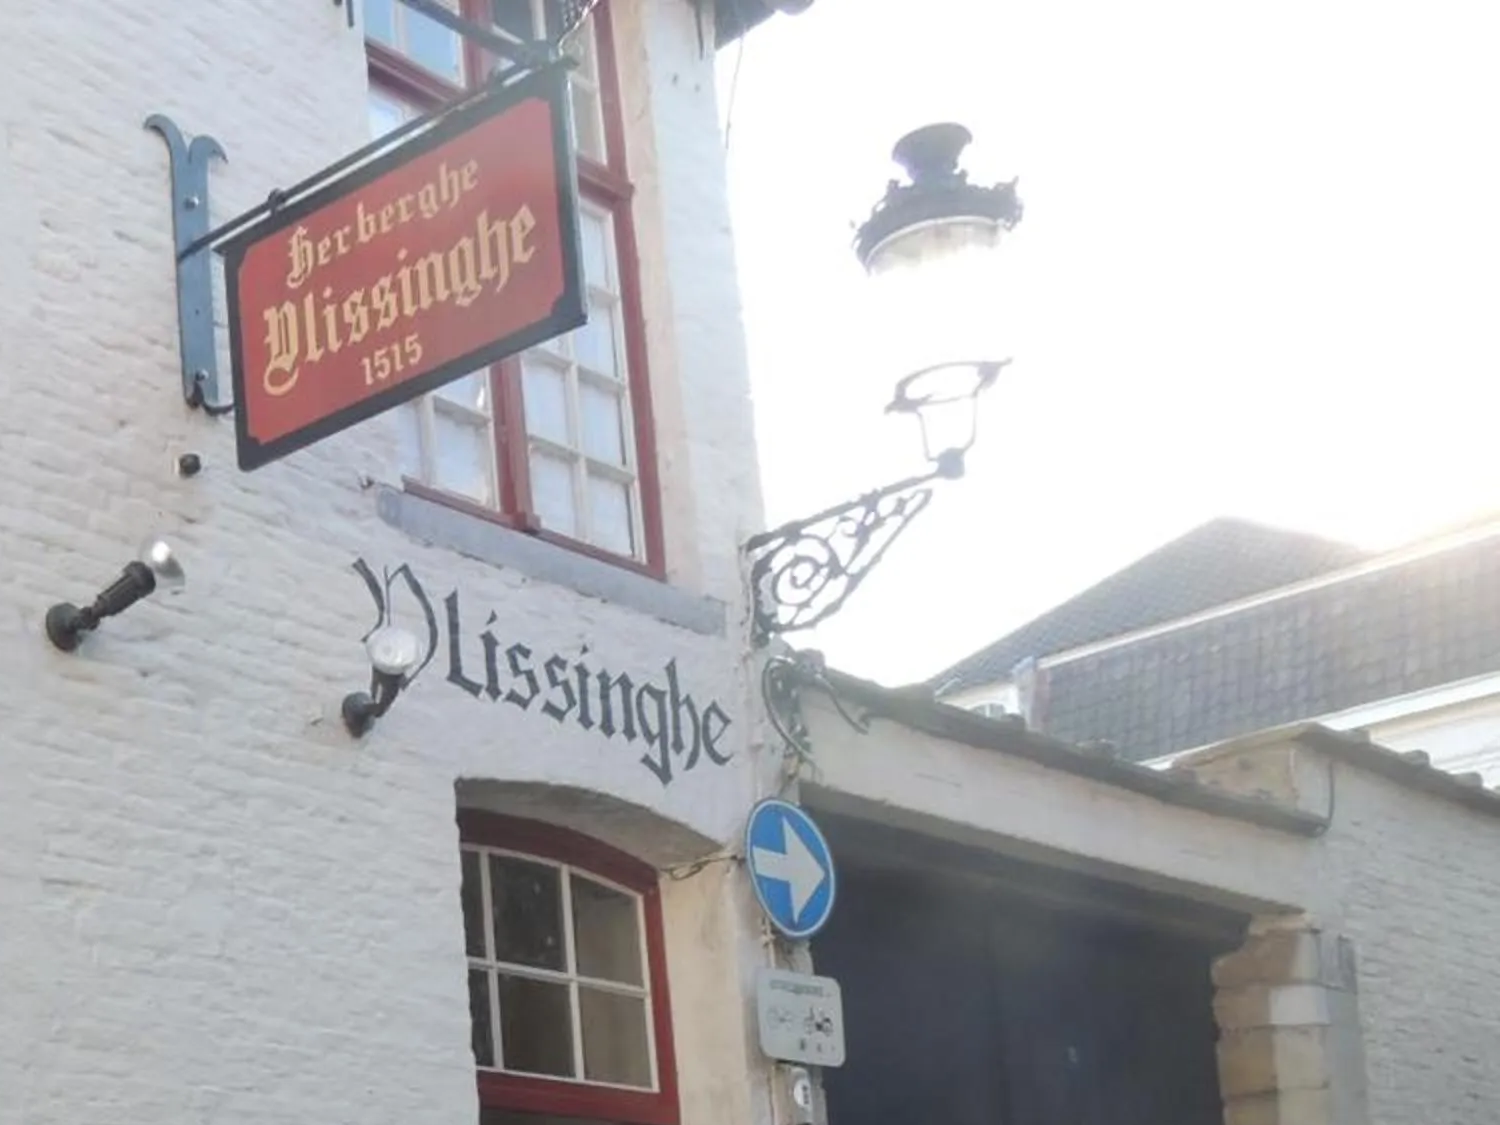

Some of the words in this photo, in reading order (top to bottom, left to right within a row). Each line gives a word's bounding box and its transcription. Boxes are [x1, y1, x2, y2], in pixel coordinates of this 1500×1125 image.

[285, 158, 478, 288] Herberghe
[262, 204, 537, 396] Vlissinghe
[361, 334, 424, 386] 1515
